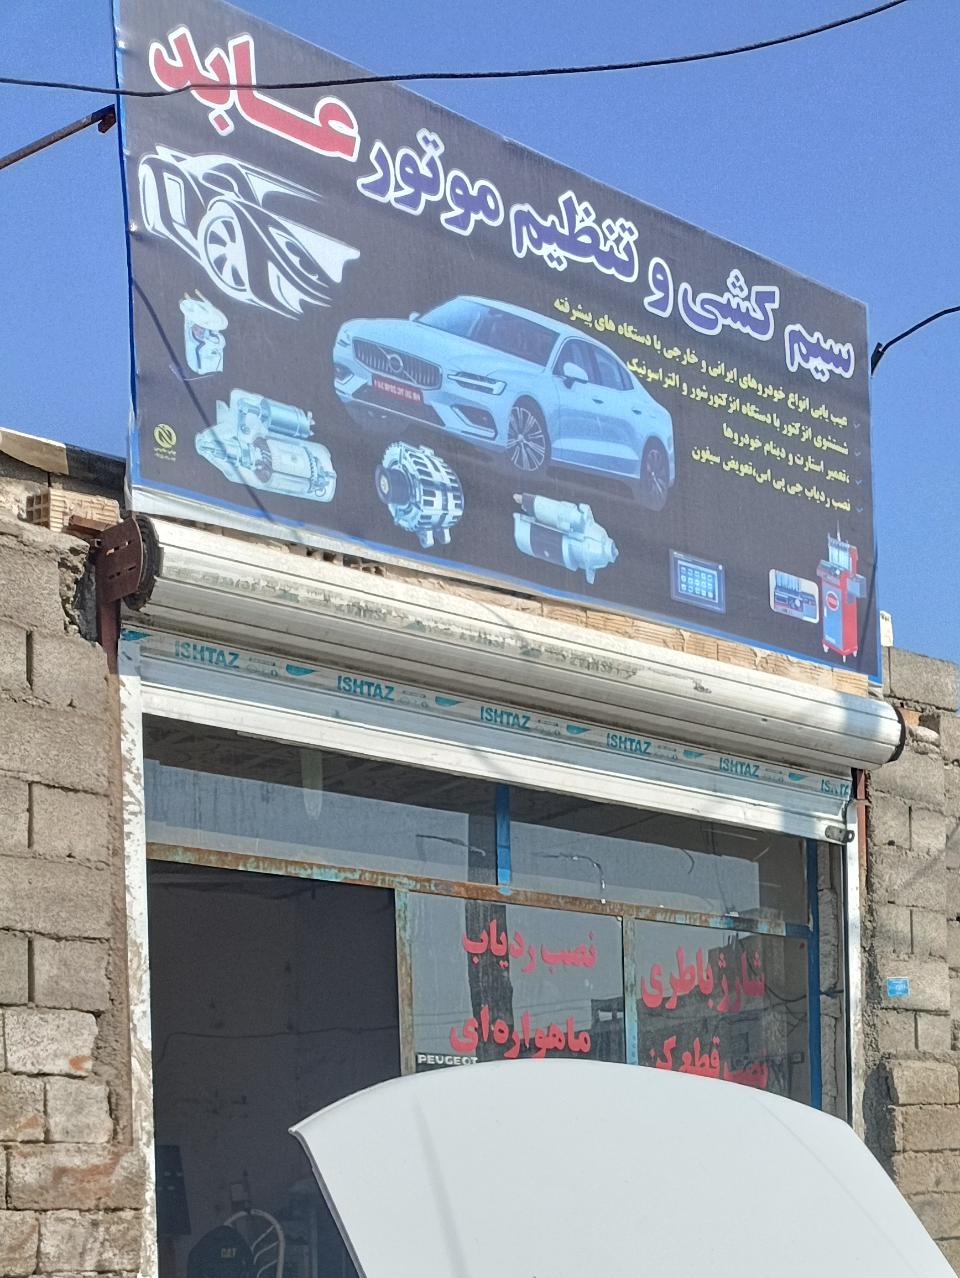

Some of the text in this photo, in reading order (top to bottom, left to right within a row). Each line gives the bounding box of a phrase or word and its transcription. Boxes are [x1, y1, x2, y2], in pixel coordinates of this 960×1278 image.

[149, 24, 854, 381] سیم کشی و تنظیم موتور عابد
[554, 297, 848, 429] عیب یابی انواع خودروهای ایرانی و خارجی با دستگاه های پیشرفته
[682, 382, 687, 395] و
[742, 403, 771, 424] دستگاه
[773, 413, 780, 431] با
[723, 423, 762, 450] خودروها
[764, 440, 786, 460] دینام
[788, 453, 793, 465] و
[795, 453, 824, 472] استارت
[832, 499, 850, 512] نصب
[175, 641, 239, 668] ISHTAZ
[337, 676, 394, 701] ISHTAZ
[481, 706, 530, 730] ISHTAZ
[607, 733, 651, 753] ISHTAZ
[720, 757, 760, 778] ISHTAZ
[462, 920, 598, 974] نصب ردیاب
[641, 945, 766, 1013] شارژ باطری
[417, 1054, 478, 1065] PEUGEOT
